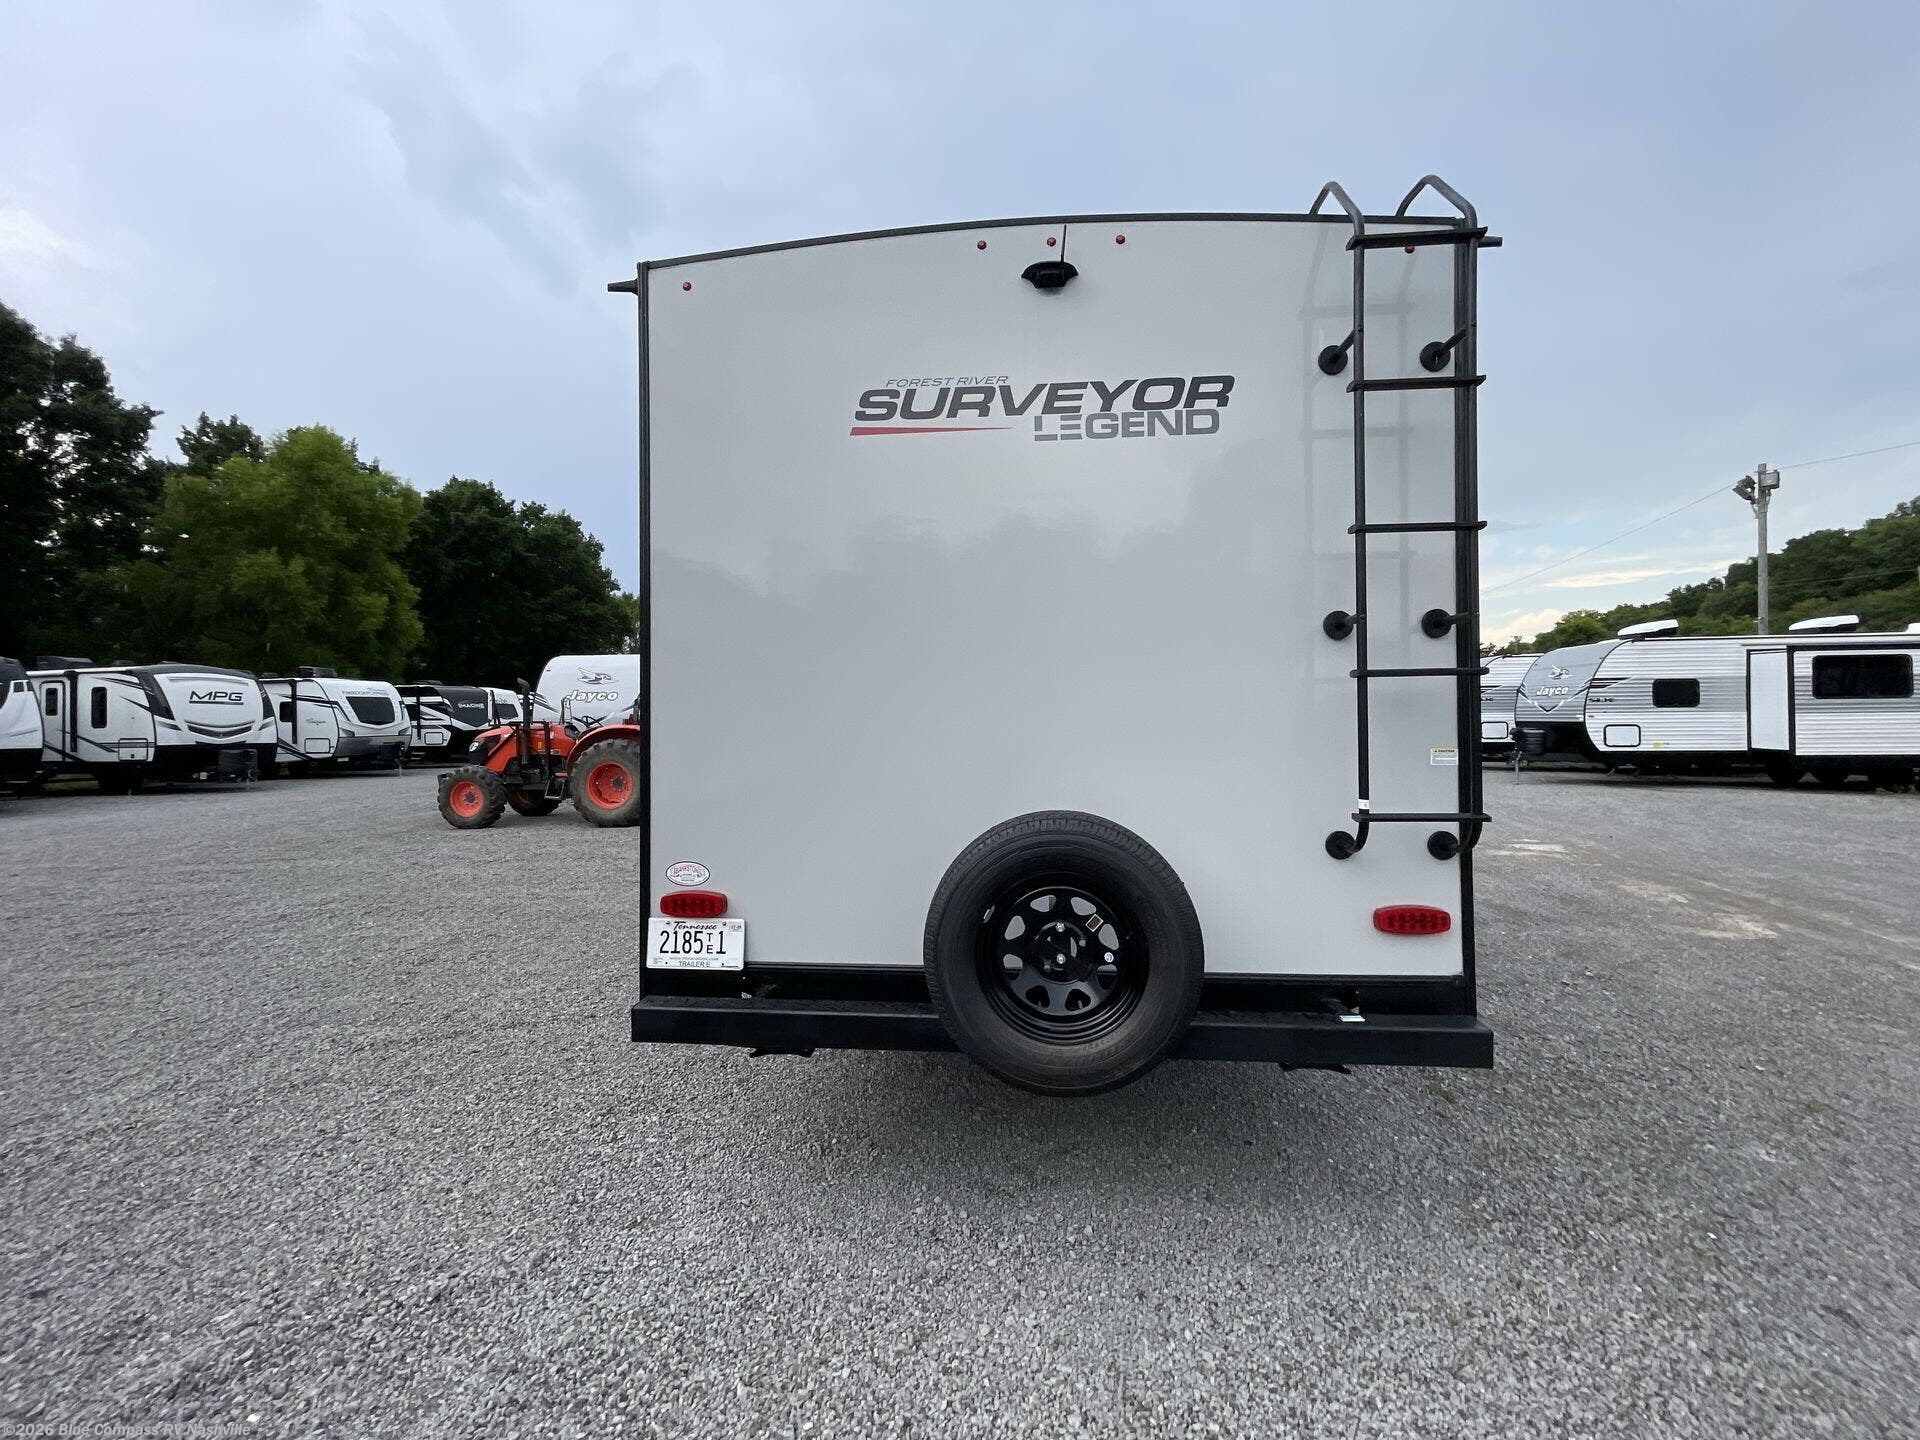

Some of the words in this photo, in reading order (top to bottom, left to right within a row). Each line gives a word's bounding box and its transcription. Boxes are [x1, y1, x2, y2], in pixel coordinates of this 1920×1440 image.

[886, 377, 955, 388] FOREST
[956, 375, 1009, 386] RIVER
[855, 375, 1235, 422] SURVEYOR
[1034, 408, 1220, 442] LEGEND
[190, 691, 243, 702] MPG
[566, 689, 619, 703] Jayco
[1536, 686, 1569, 697] Jayco
[672, 920, 718, 931] Tennessee
